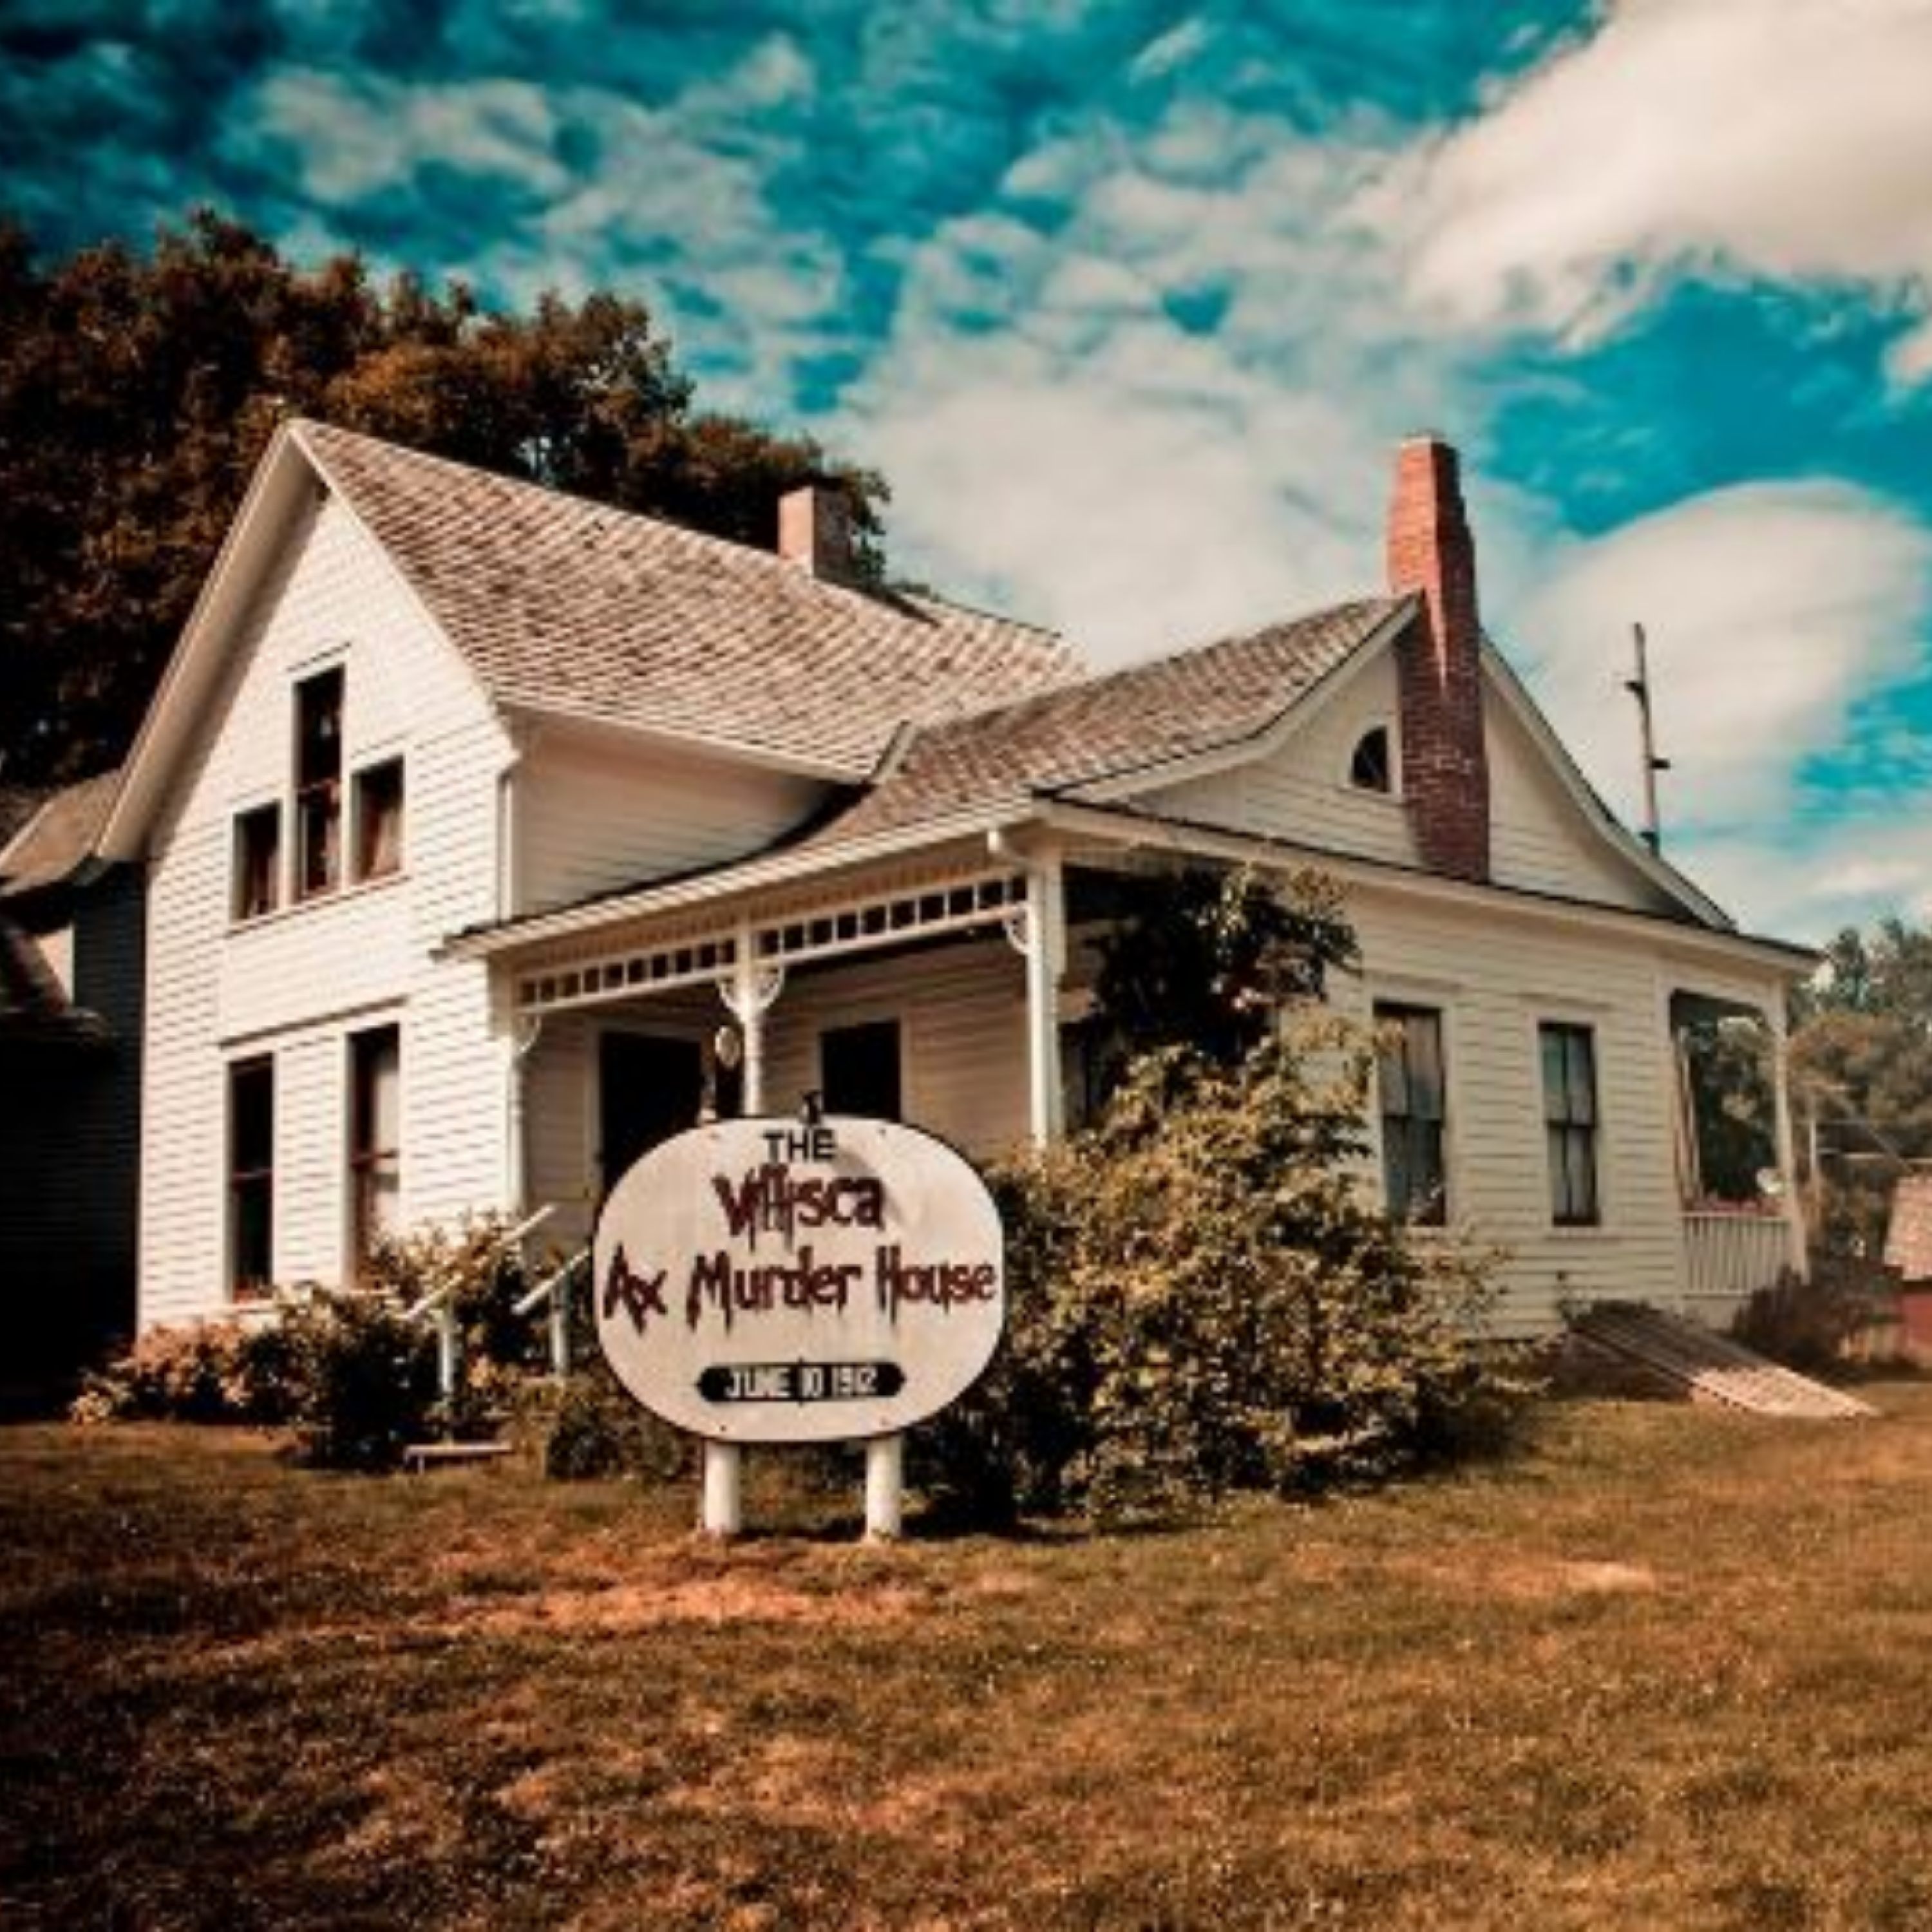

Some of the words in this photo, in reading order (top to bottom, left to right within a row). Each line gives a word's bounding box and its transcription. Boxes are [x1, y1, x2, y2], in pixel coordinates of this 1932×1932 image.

[762, 1129, 836, 1162] THE
[603, 1242, 668, 1335] Ax
[686, 1245, 862, 1335] Murder
[875, 1244, 997, 1328] House
[724, 1366, 791, 1399] JUNE
[798, 1366, 824, 1399] 10
